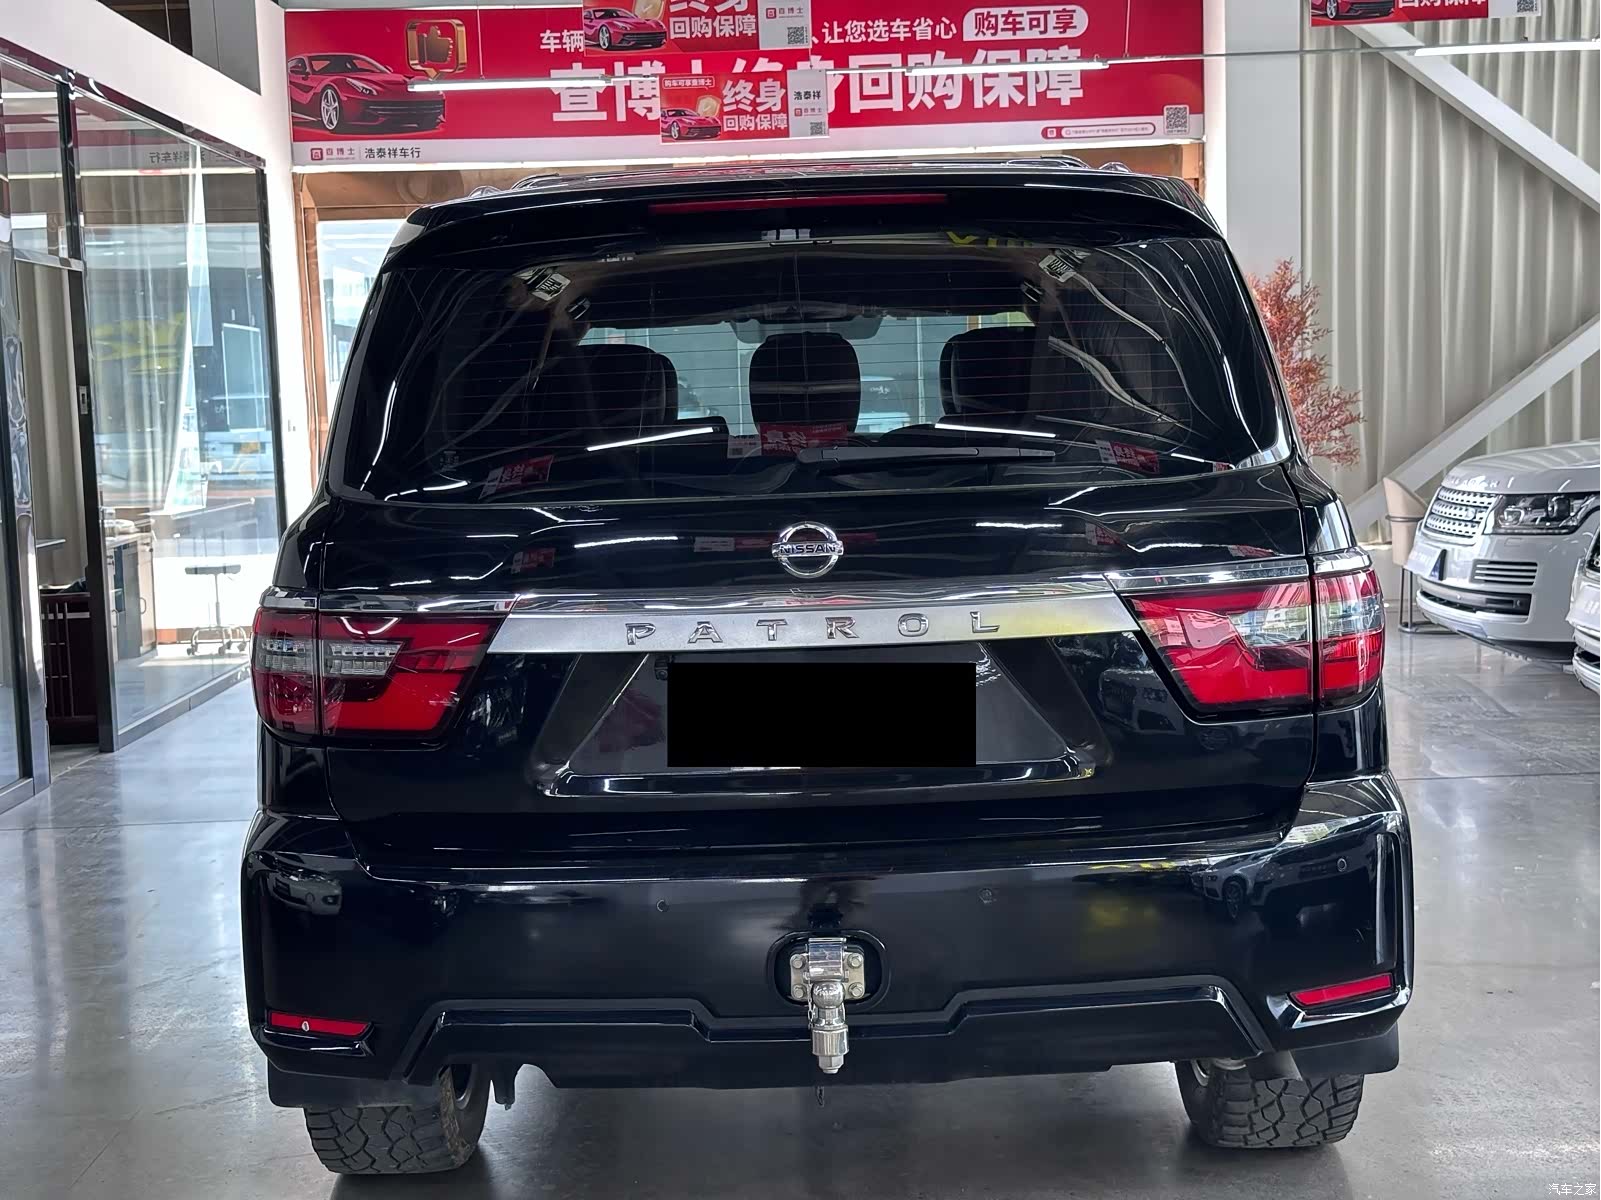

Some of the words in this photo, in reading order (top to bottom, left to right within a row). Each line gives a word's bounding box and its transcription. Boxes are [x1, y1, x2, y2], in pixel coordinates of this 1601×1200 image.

[540, 29, 584, 53] 车辆
[822, 16, 957, 44] 让您选车省心
[669, 14, 757, 39] 回购保障
[974, 8, 1077, 37] 购车可享
[722, 78, 786, 113] 终身
[723, 113, 788, 132] 回购保障
[364, 147, 421, 159] 浩泰祥车行
[780, 542, 837, 555] NISSAN
[625, 610, 1000, 646] PATROL
